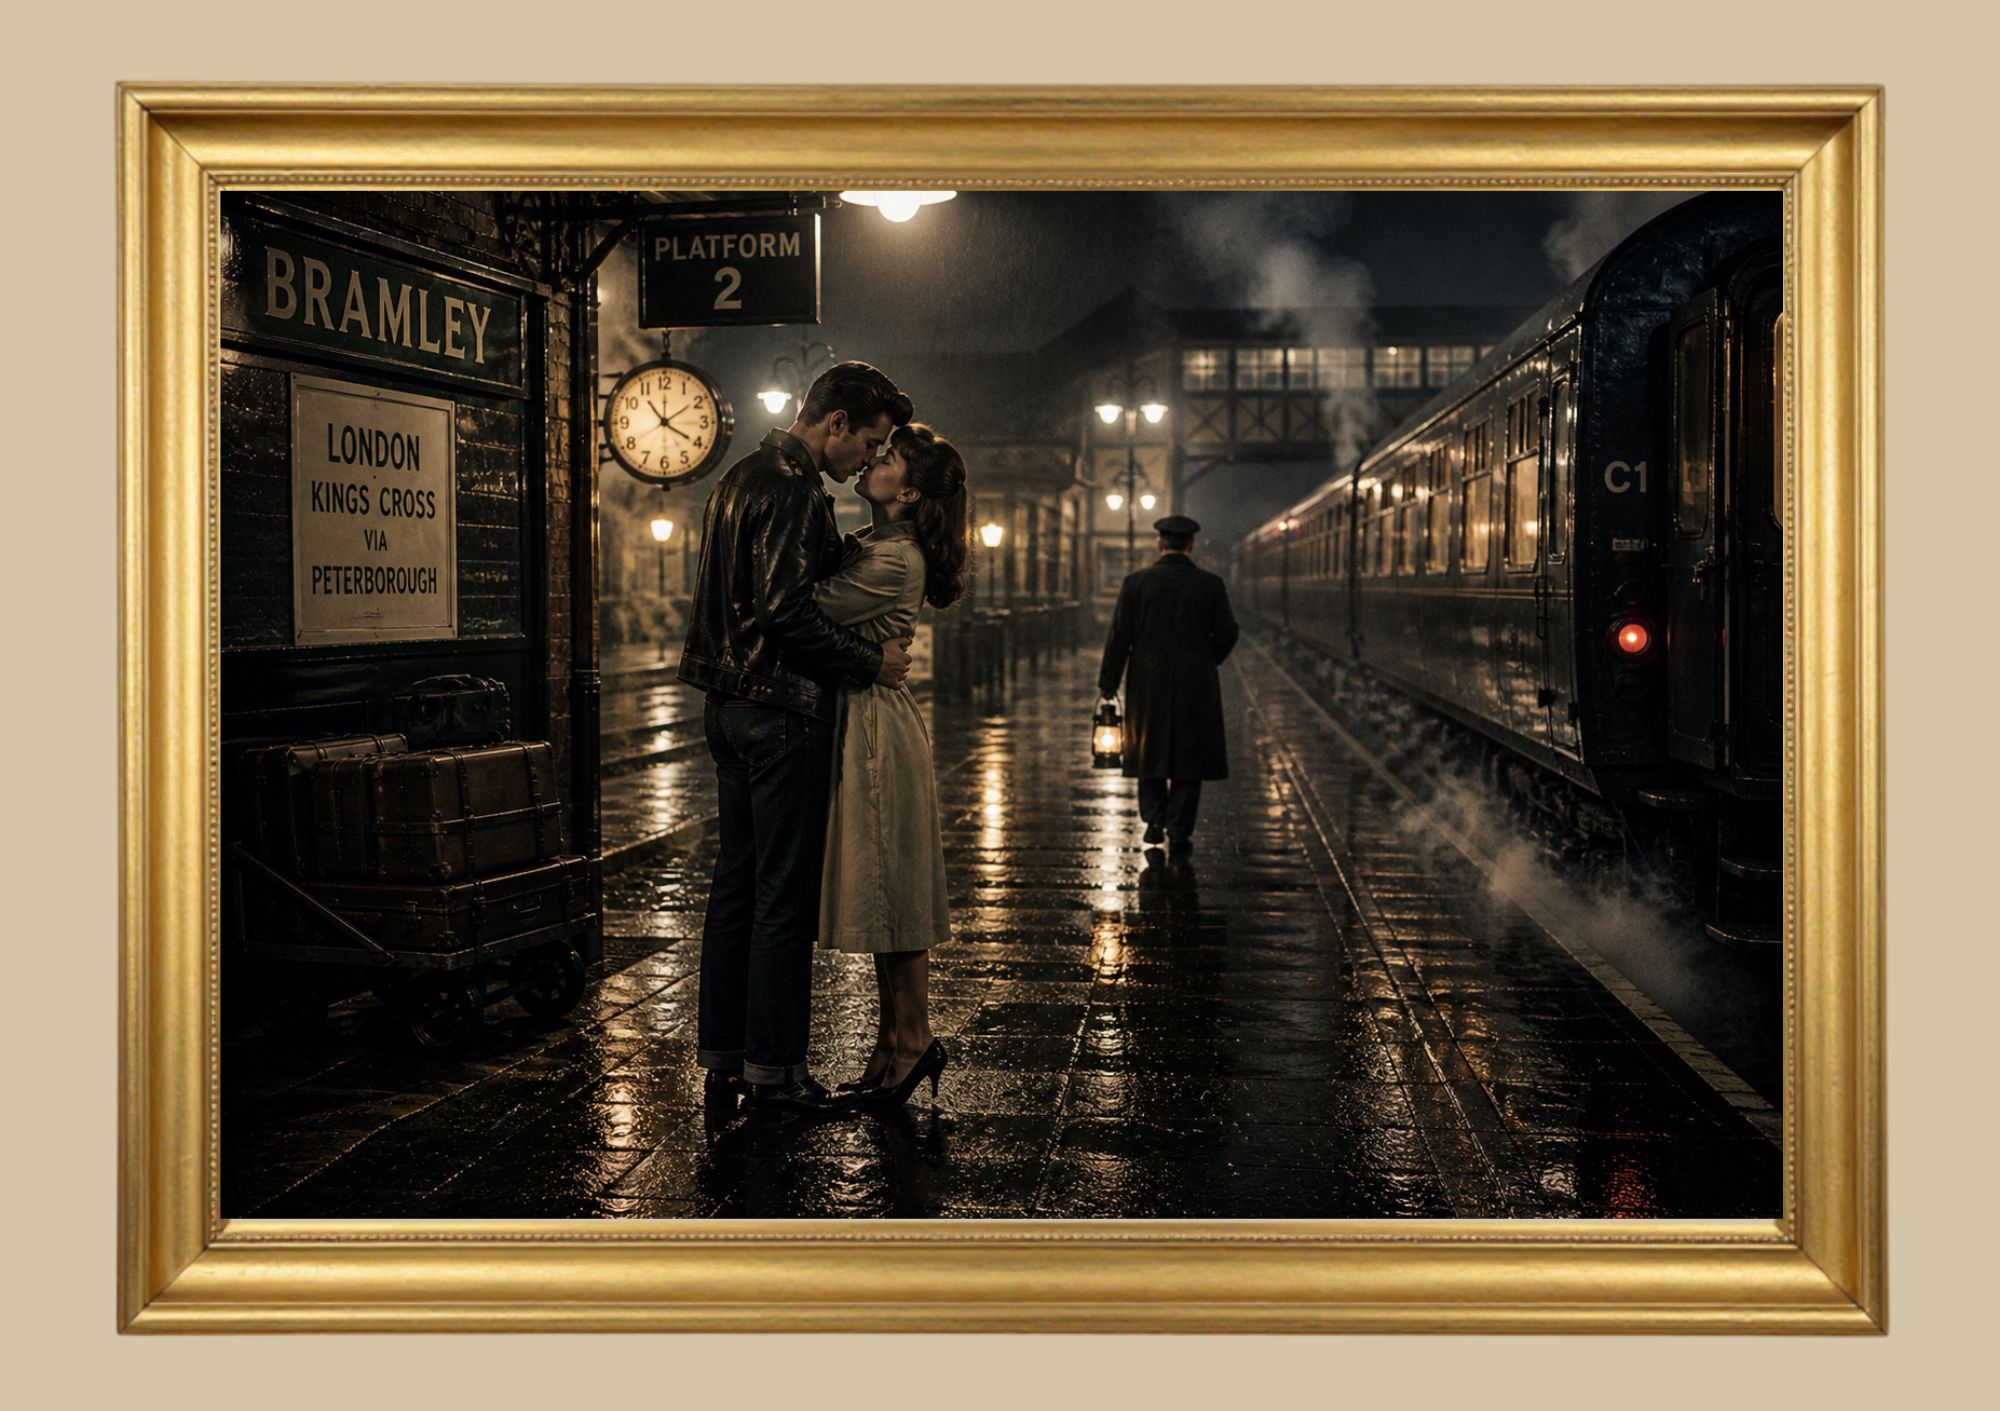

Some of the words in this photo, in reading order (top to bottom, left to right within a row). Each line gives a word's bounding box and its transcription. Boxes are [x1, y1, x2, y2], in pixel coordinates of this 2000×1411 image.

[655, 232, 800, 261] PLATFORM
[714, 266, 742, 310] 2
[265, 246, 491, 365] BRAMLEY
[641, 382, 650, 396] 11
[658, 376, 671, 390] 12
[625, 397, 638, 410] 10
[693, 395, 703, 409] 2
[620, 416, 629, 429] 9
[700, 415, 709, 429] 3
[327, 422, 420, 471] LONDON
[626, 436, 636, 450] 8
[693, 436, 702, 449] 4
[641, 451, 651, 465] 7
[660, 456, 669, 470] 6
[680, 450, 689, 464] 5
[1604, 460, 1648, 493] C1
[311, 481, 369, 515] KINGS
[380, 487, 436, 519] CROSS
[364, 529, 388, 552] VIA
[312, 565, 437, 595] PETERBOROUGH
